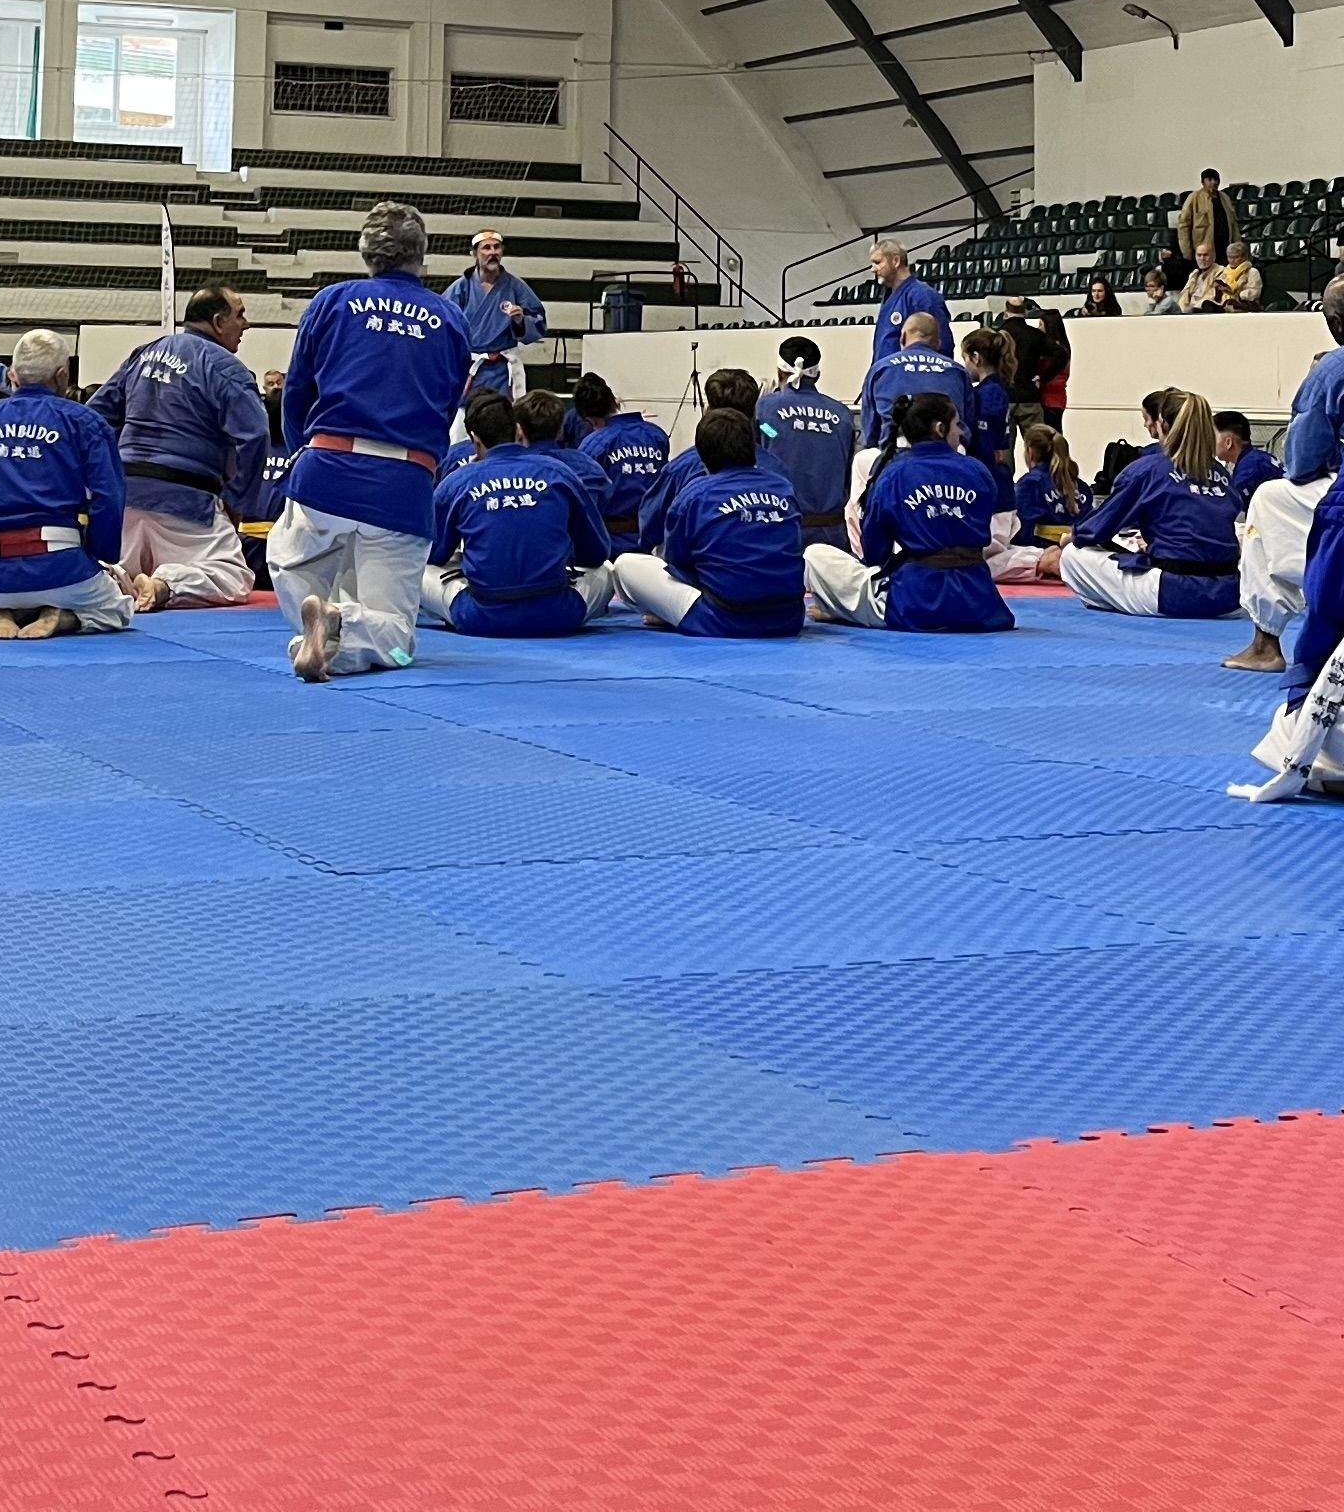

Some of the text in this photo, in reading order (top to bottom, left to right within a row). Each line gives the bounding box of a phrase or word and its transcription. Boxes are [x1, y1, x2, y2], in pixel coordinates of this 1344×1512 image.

[348, 297, 442, 330] NANBUDO
[890, 355, 953, 368] NANBUDO
[777, 406, 841, 425] NANBUDO
[608, 446, 663, 465] NANBUDO
[468, 477, 548, 502] NANBUDO
[903, 484, 977, 510] NANBUDO
[718, 492, 789, 515] NANBUDO
